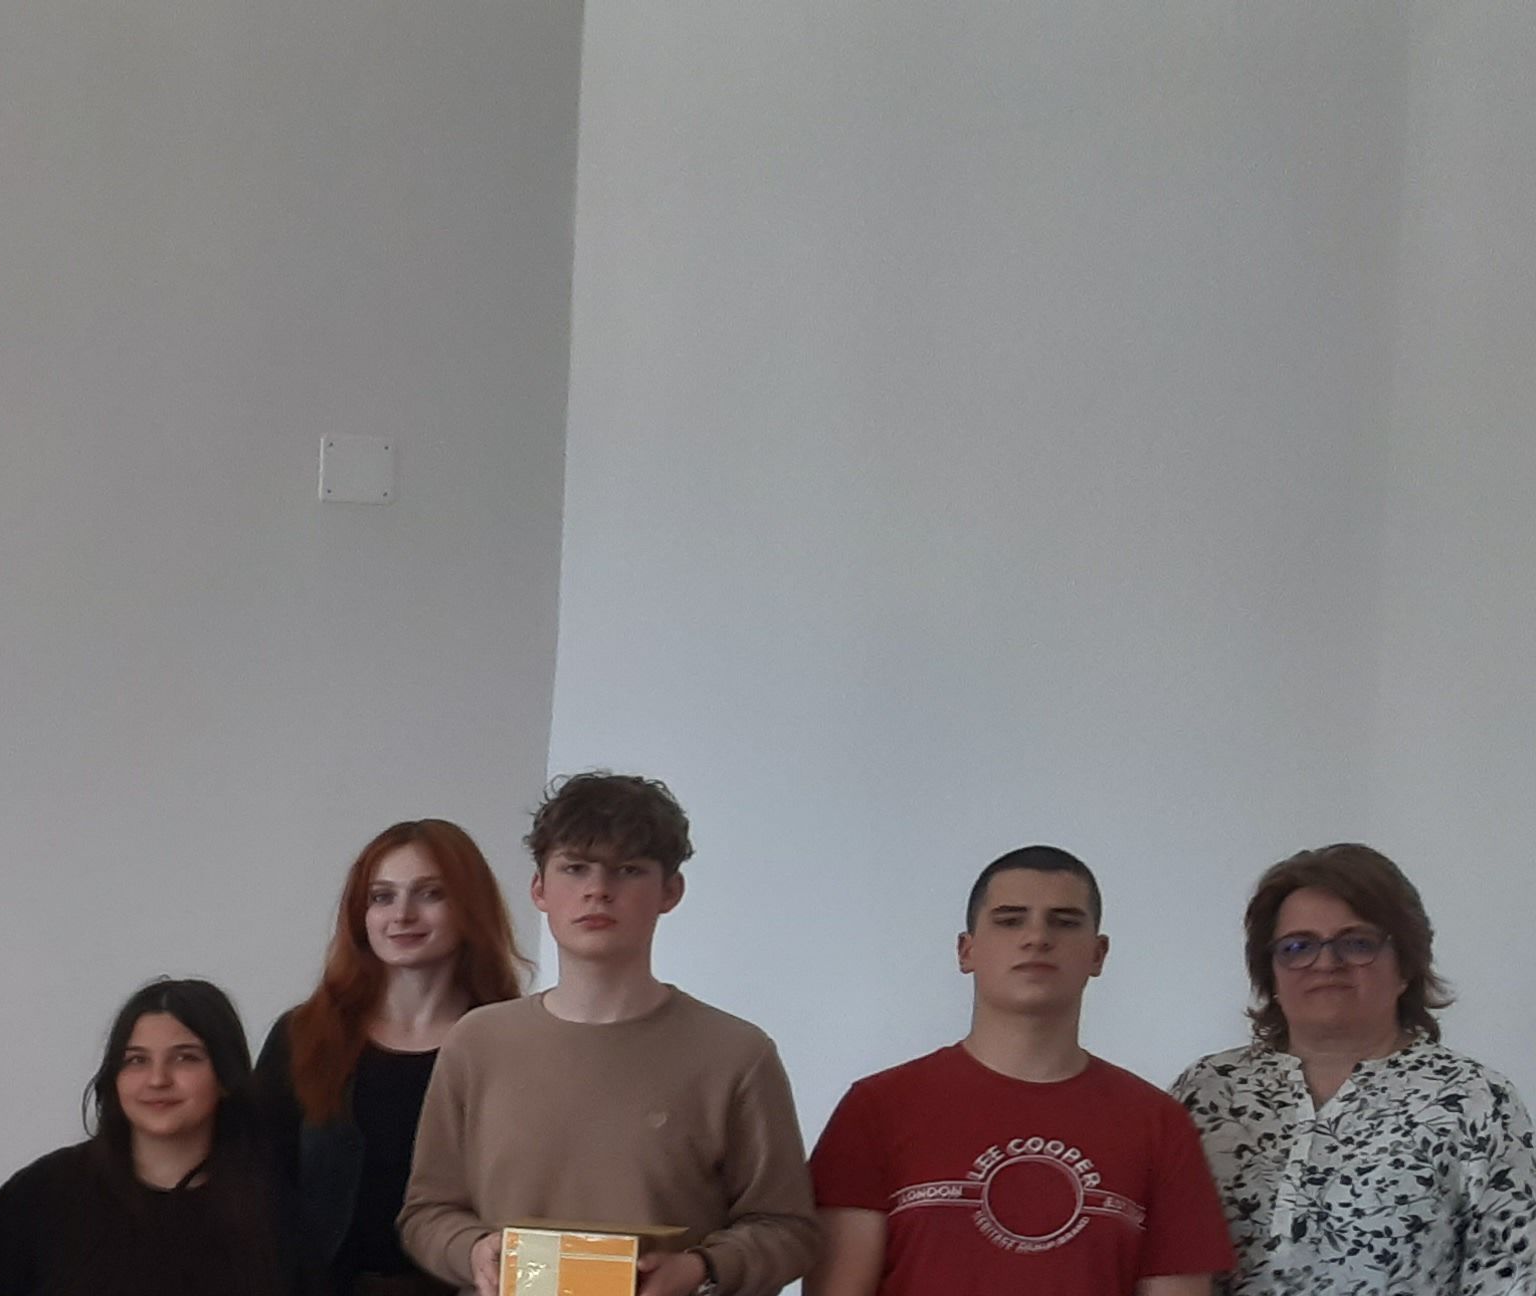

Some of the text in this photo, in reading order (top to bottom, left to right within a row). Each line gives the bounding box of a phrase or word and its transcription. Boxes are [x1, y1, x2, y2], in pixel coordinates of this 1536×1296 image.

[966, 1135, 1102, 1187] LEE COOPER
[898, 1185, 964, 1205] LONDON
